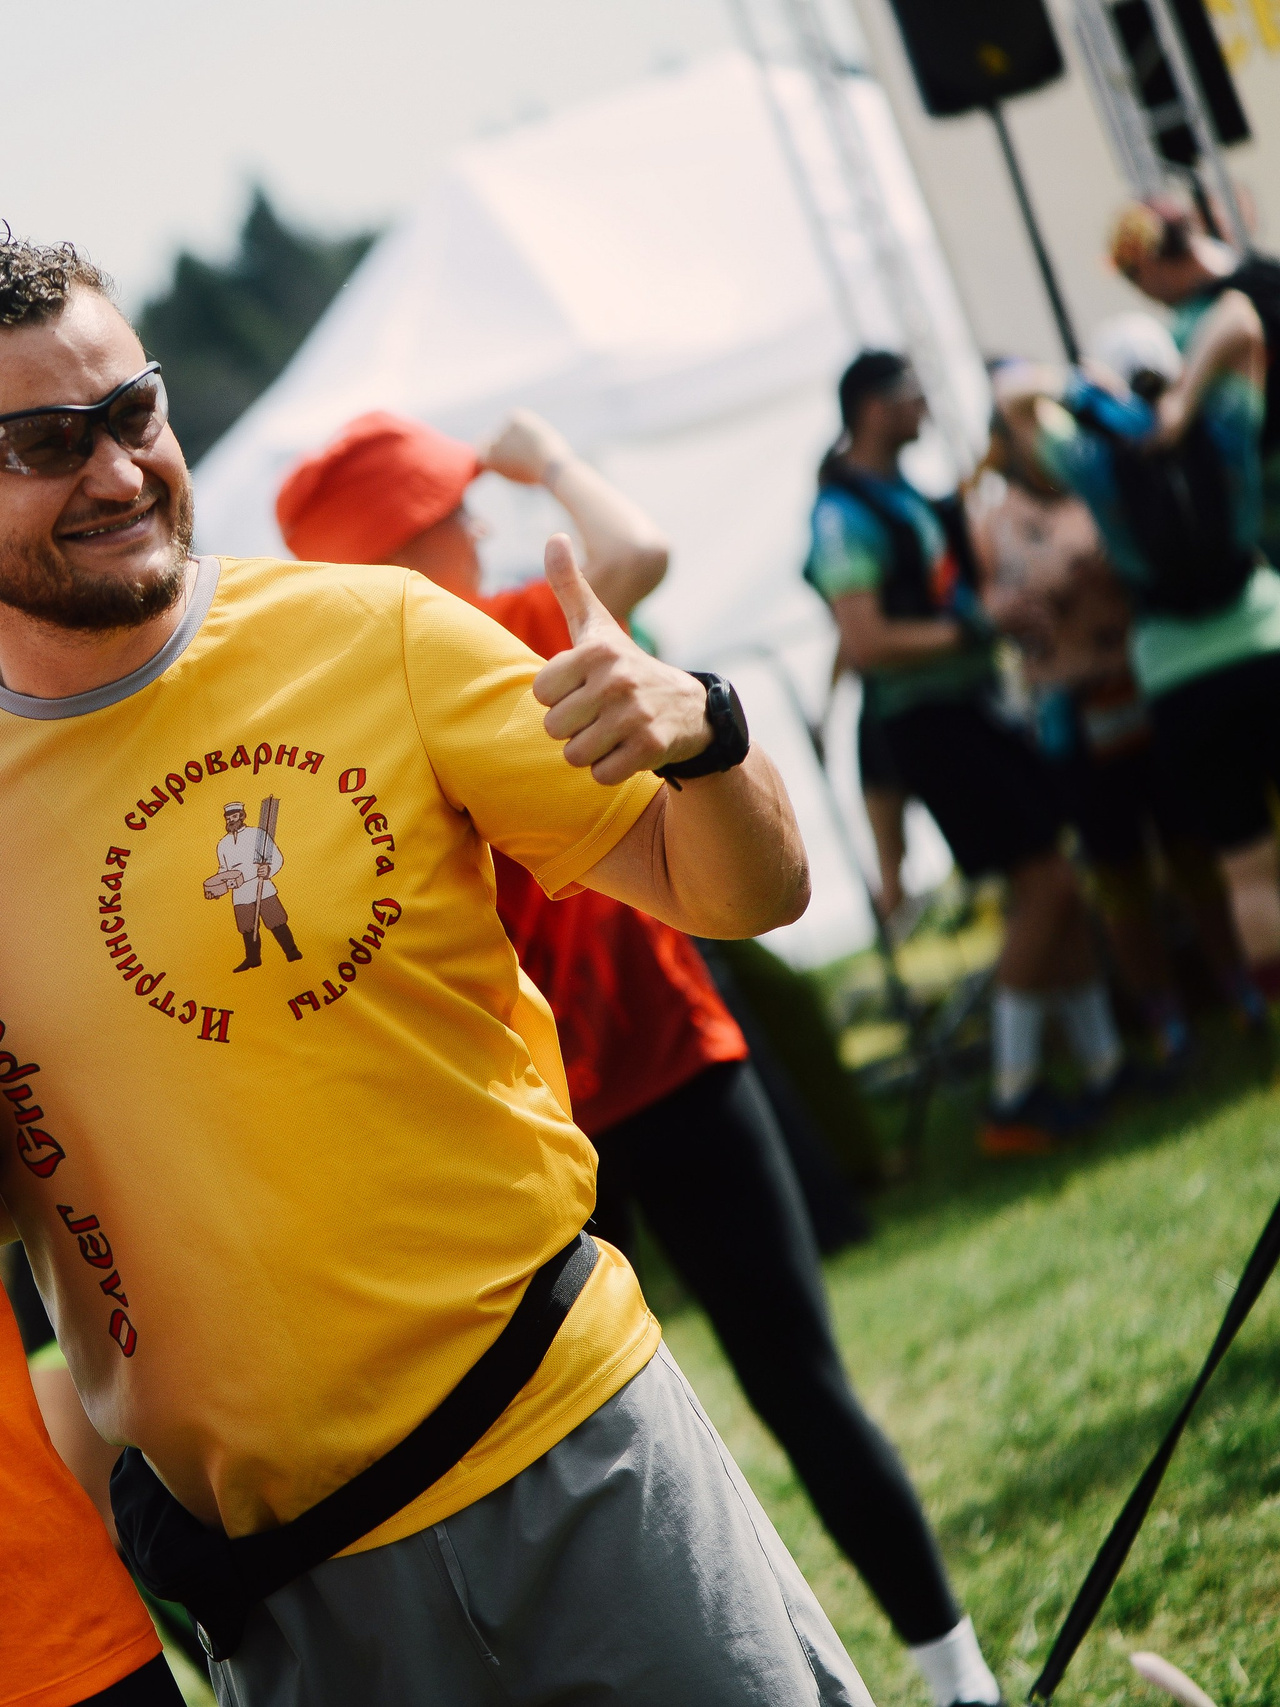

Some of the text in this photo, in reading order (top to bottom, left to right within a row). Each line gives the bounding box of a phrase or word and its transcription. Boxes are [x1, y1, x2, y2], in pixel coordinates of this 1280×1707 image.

[99, 742, 402, 1043] Истринская сыроварня Олега Сироты
